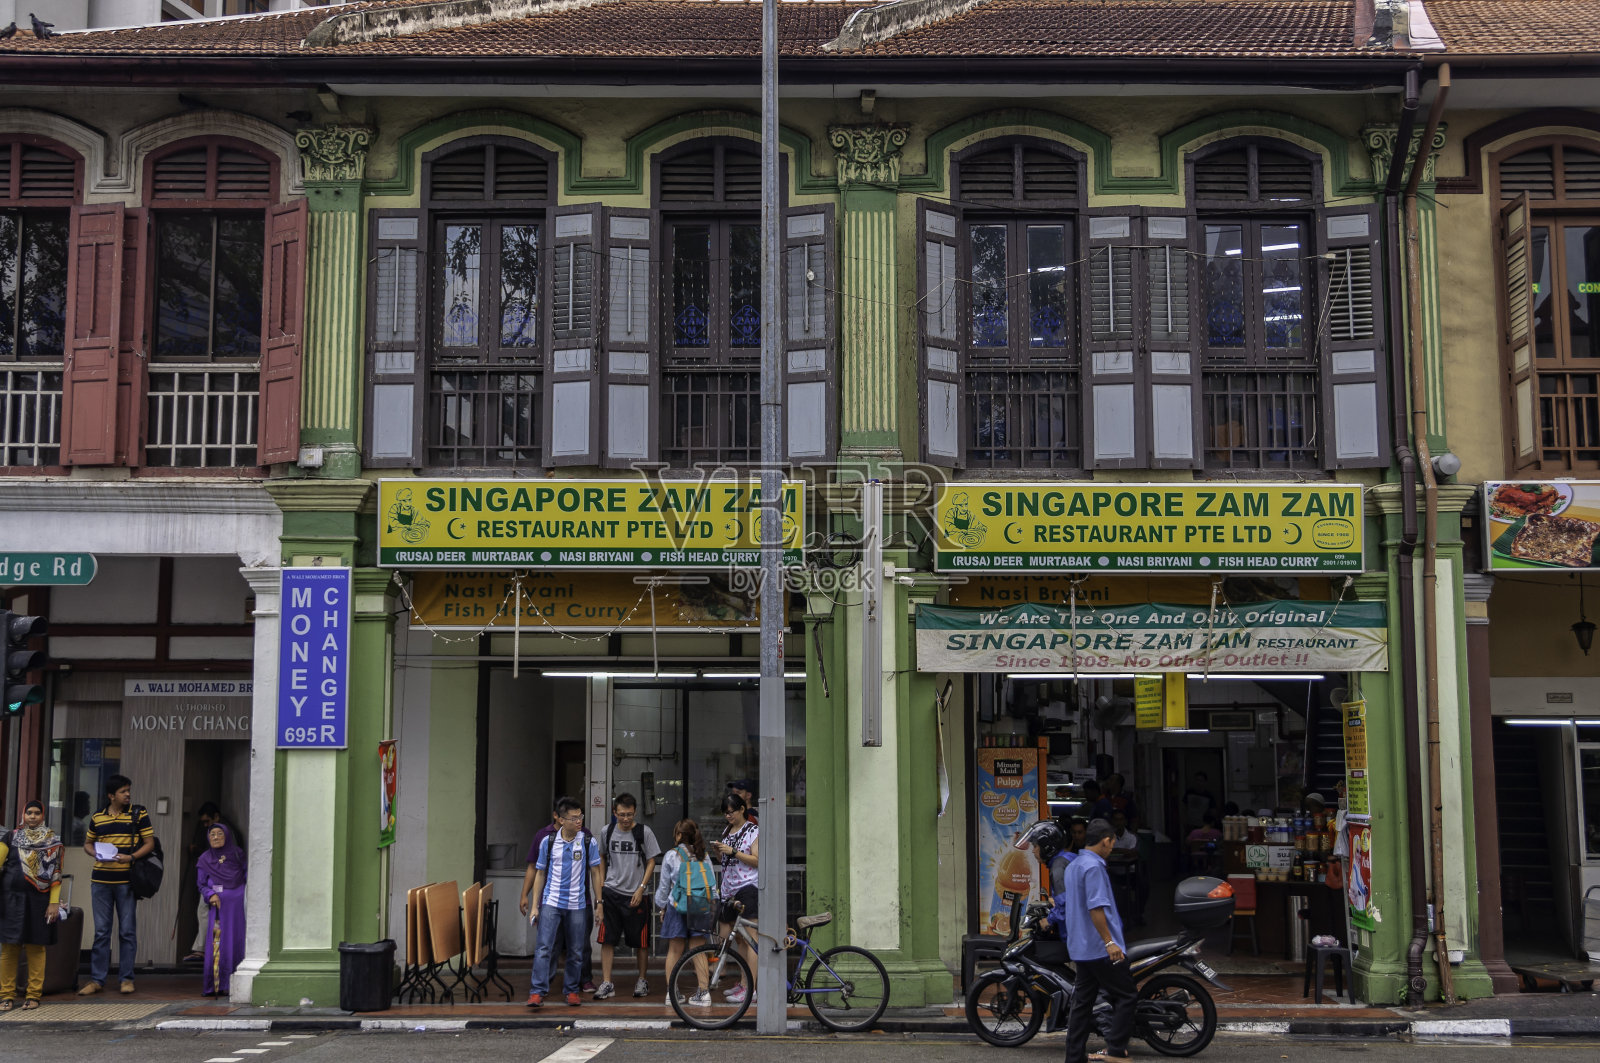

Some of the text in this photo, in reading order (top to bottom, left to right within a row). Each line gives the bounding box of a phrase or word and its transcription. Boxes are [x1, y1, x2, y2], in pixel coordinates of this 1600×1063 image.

[425, 487, 627, 512] SINGAPORE
[638, 488, 711, 513] ZAM
[982, 491, 1355, 517] SINGAPORE ZAM ZAM
[477, 520, 714, 538] RESTAURANT PTE LTD
[1034, 525, 1272, 543] RESTAURANT PTE LTD
[395, 551, 760, 563] (RUSA) DEER MURTABAK NASI BRIYANI FISH HEAD CURRY
[952, 556, 1319, 567] (RUSA) DEER MURTABAK NASI BRIYANI FISH HEAD CURRY
[0, 556, 82, 582] dge Rd
[445, 583, 493, 598] Nasi
[980, 586, 1029, 601] Nasi
[444, 603, 627, 620] Fish Head Curry
[979, 610, 1326, 626] We Are The One And Only Original
[946, 632, 1359, 650] SINGAPORE ZAM ZAM RESTAURANT
[290, 587, 312, 717] MONEY
[320, 587, 340, 743] CHANGER
[995, 655, 1051, 668] Since
[1124, 656, 1151, 668] No
[1158, 655, 1216, 668] Other
[1223, 653, 1288, 667] Outlet
[148, 683, 175, 693] WALI
[178, 683, 236, 693] MOHAMED
[176, 703, 226, 712] AUTHORISED
[130, 715, 187, 731] MONEY
[284, 728, 317, 743] 695
[997, 777, 1022, 788] Pulpy
